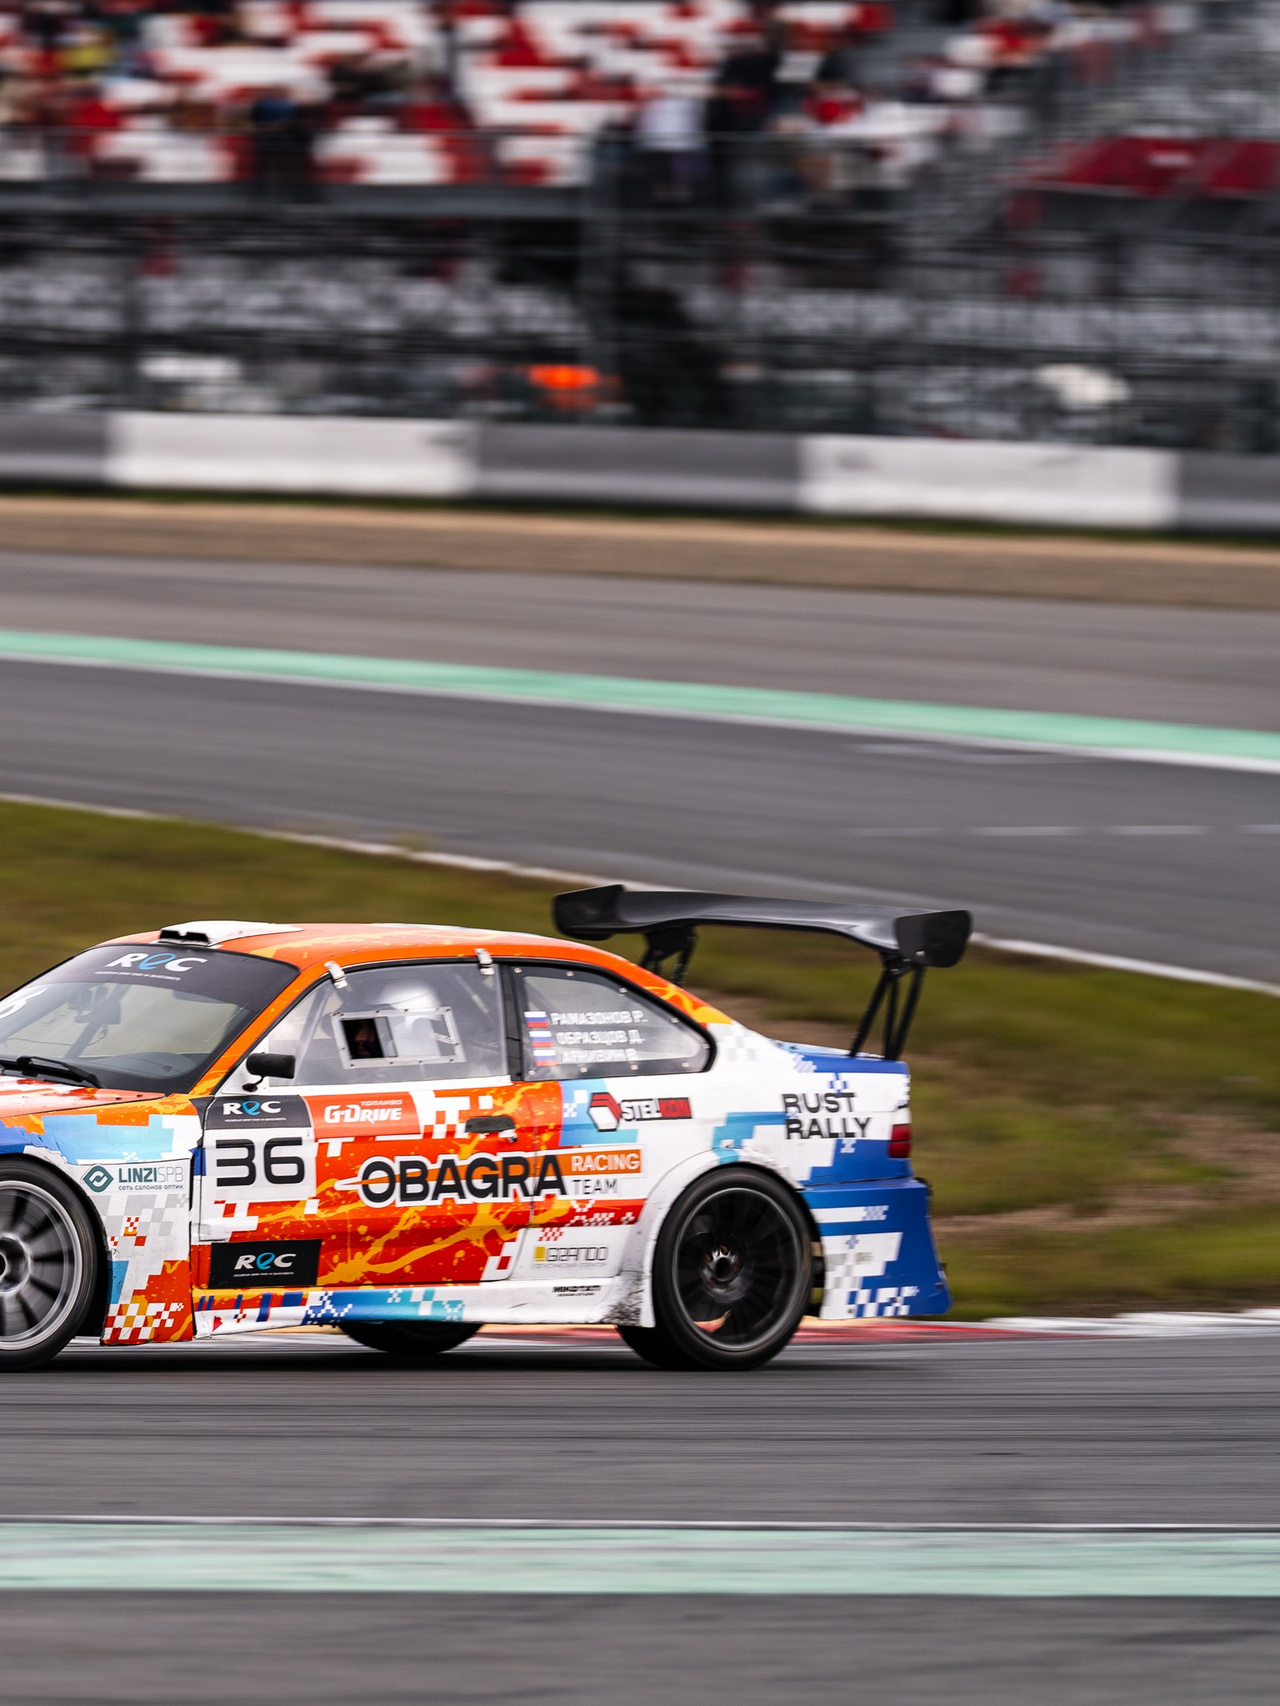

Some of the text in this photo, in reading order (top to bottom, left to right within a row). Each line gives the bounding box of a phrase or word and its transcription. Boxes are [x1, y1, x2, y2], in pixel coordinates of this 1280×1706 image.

[782, 1092, 856, 1113] RUST
[785, 1117, 873, 1139] RALLY
[215, 1137, 305, 1187] 36
[571, 1152, 640, 1172] RACING
[361, 1153, 568, 1203] OBAGRA
[573, 1178, 619, 1195] TEAM
